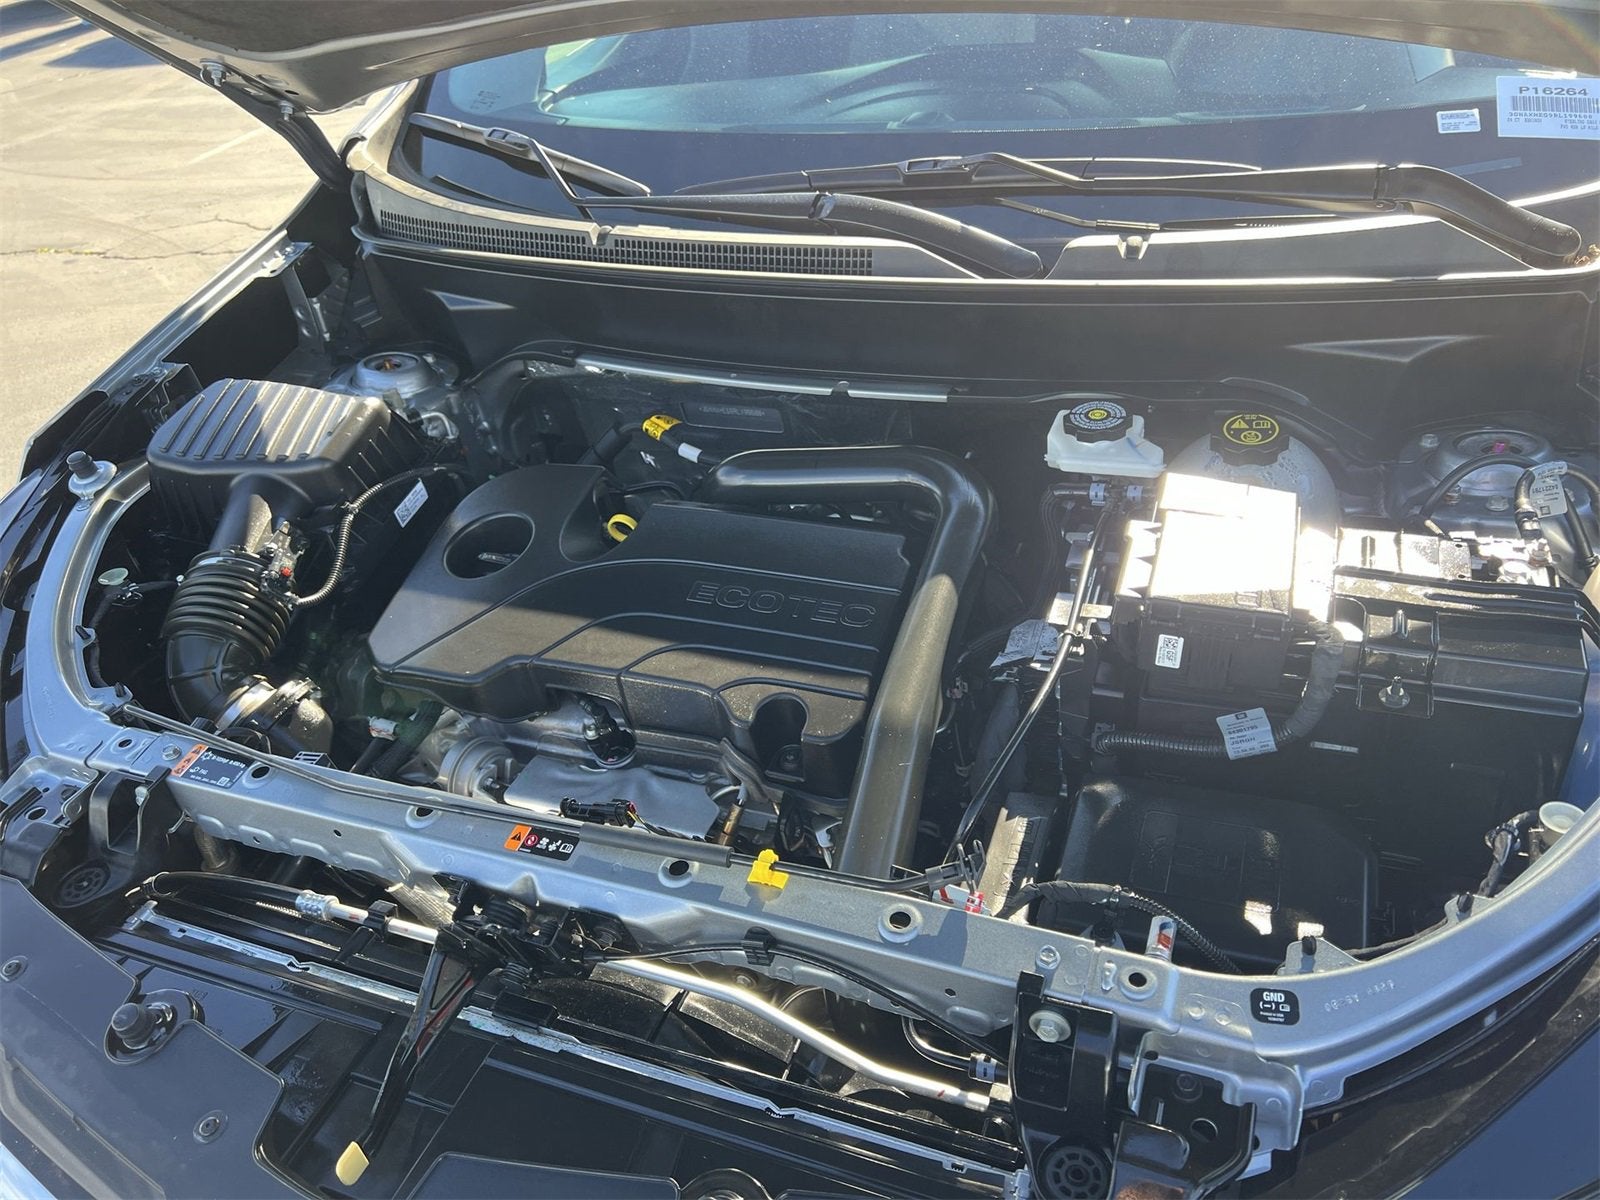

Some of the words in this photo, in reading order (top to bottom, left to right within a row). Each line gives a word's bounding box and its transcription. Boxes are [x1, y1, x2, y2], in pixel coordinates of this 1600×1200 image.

[1519, 86, 1588, 96] P16264
[686, 580, 877, 628] ECOTEC
[1263, 991, 1285, 1002] GND
